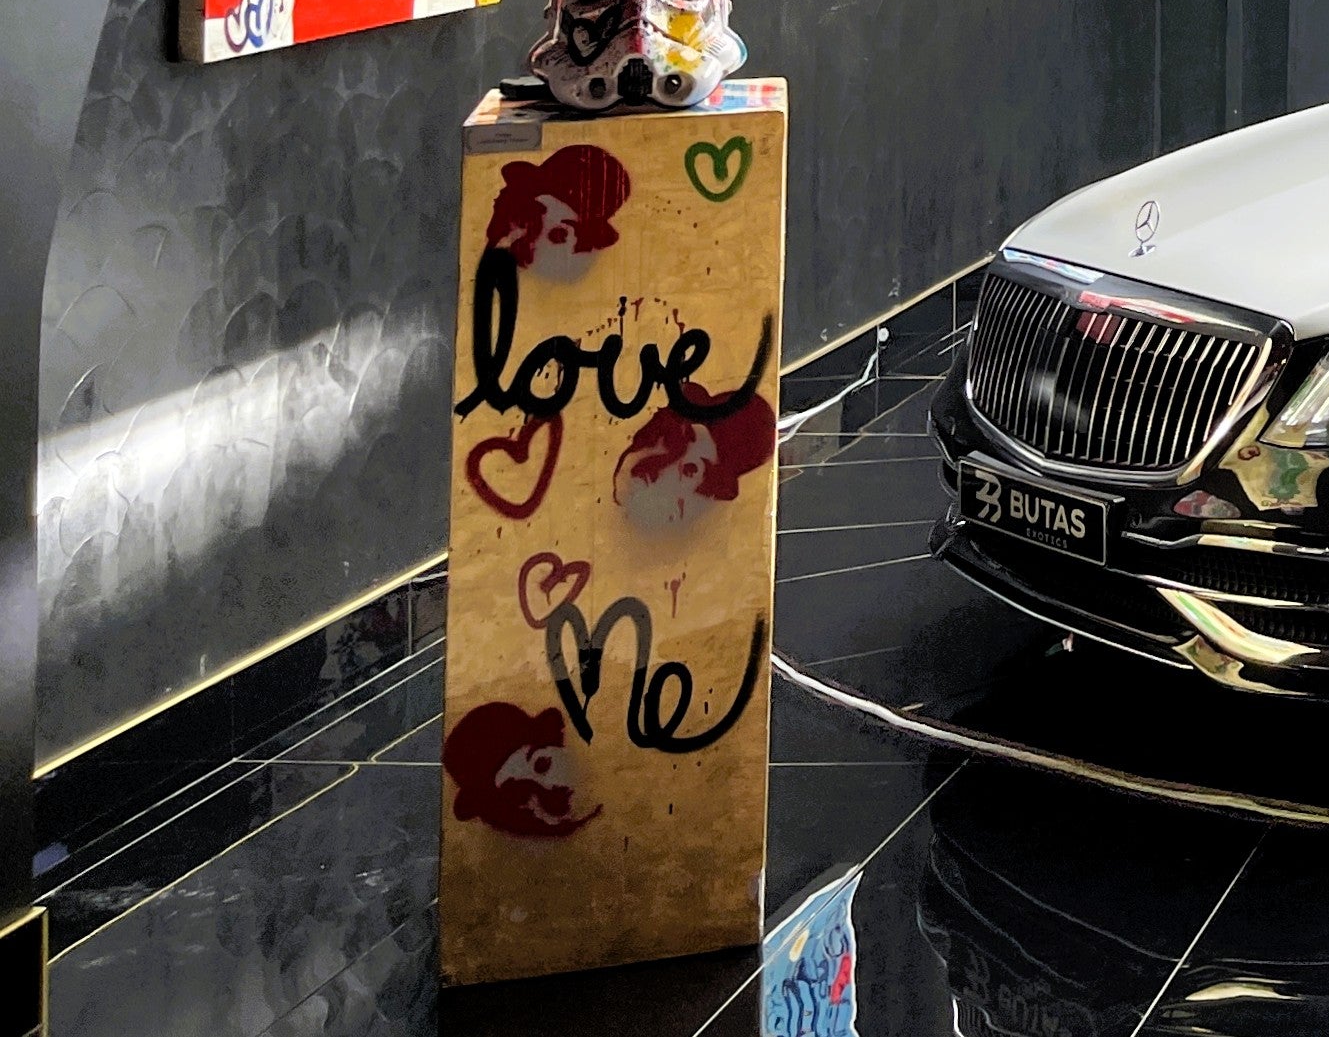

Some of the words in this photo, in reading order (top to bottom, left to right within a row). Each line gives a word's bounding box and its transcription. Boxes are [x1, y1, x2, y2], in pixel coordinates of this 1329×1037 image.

[454, 246, 774, 423] love
[1010, 489, 1086, 539] BUTAS
[1026, 527, 1068, 549] EXOTICS
